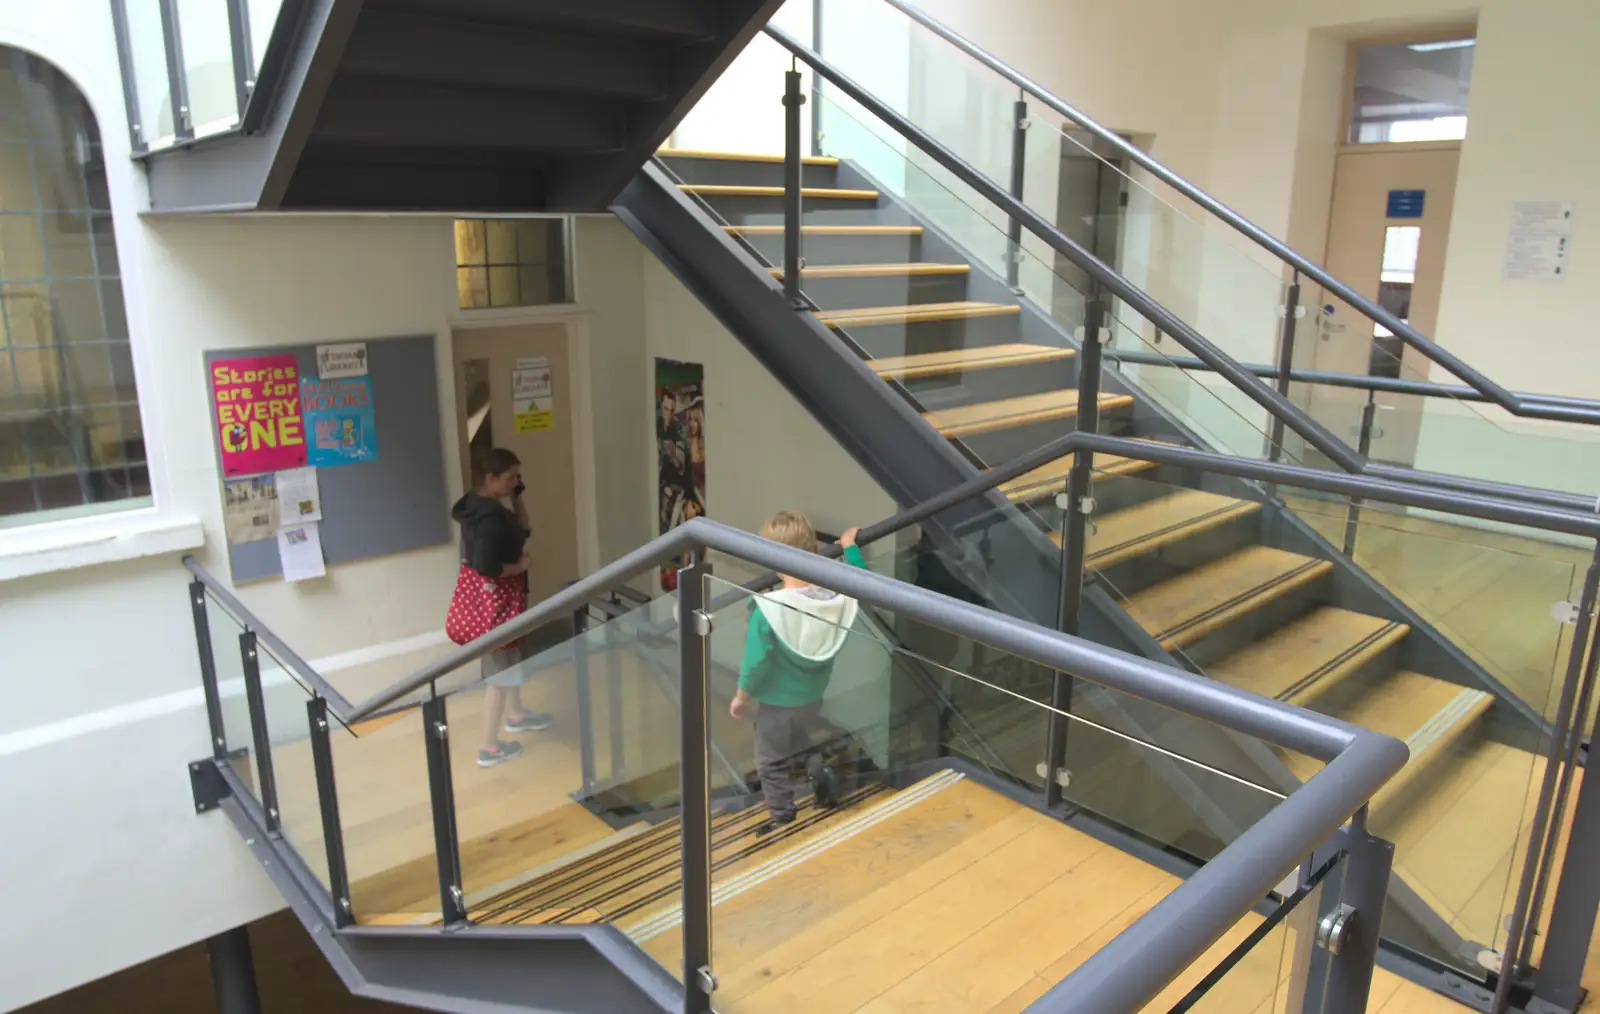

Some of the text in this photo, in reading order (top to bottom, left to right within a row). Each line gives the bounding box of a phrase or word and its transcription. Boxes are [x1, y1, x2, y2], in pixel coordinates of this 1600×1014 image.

[213, 366, 296, 386] Stories
[216, 380, 297, 402] are for
[303, 391, 369, 411] BOOKS
[218, 398, 298, 424] EVERY
[221, 415, 304, 453] ONE
